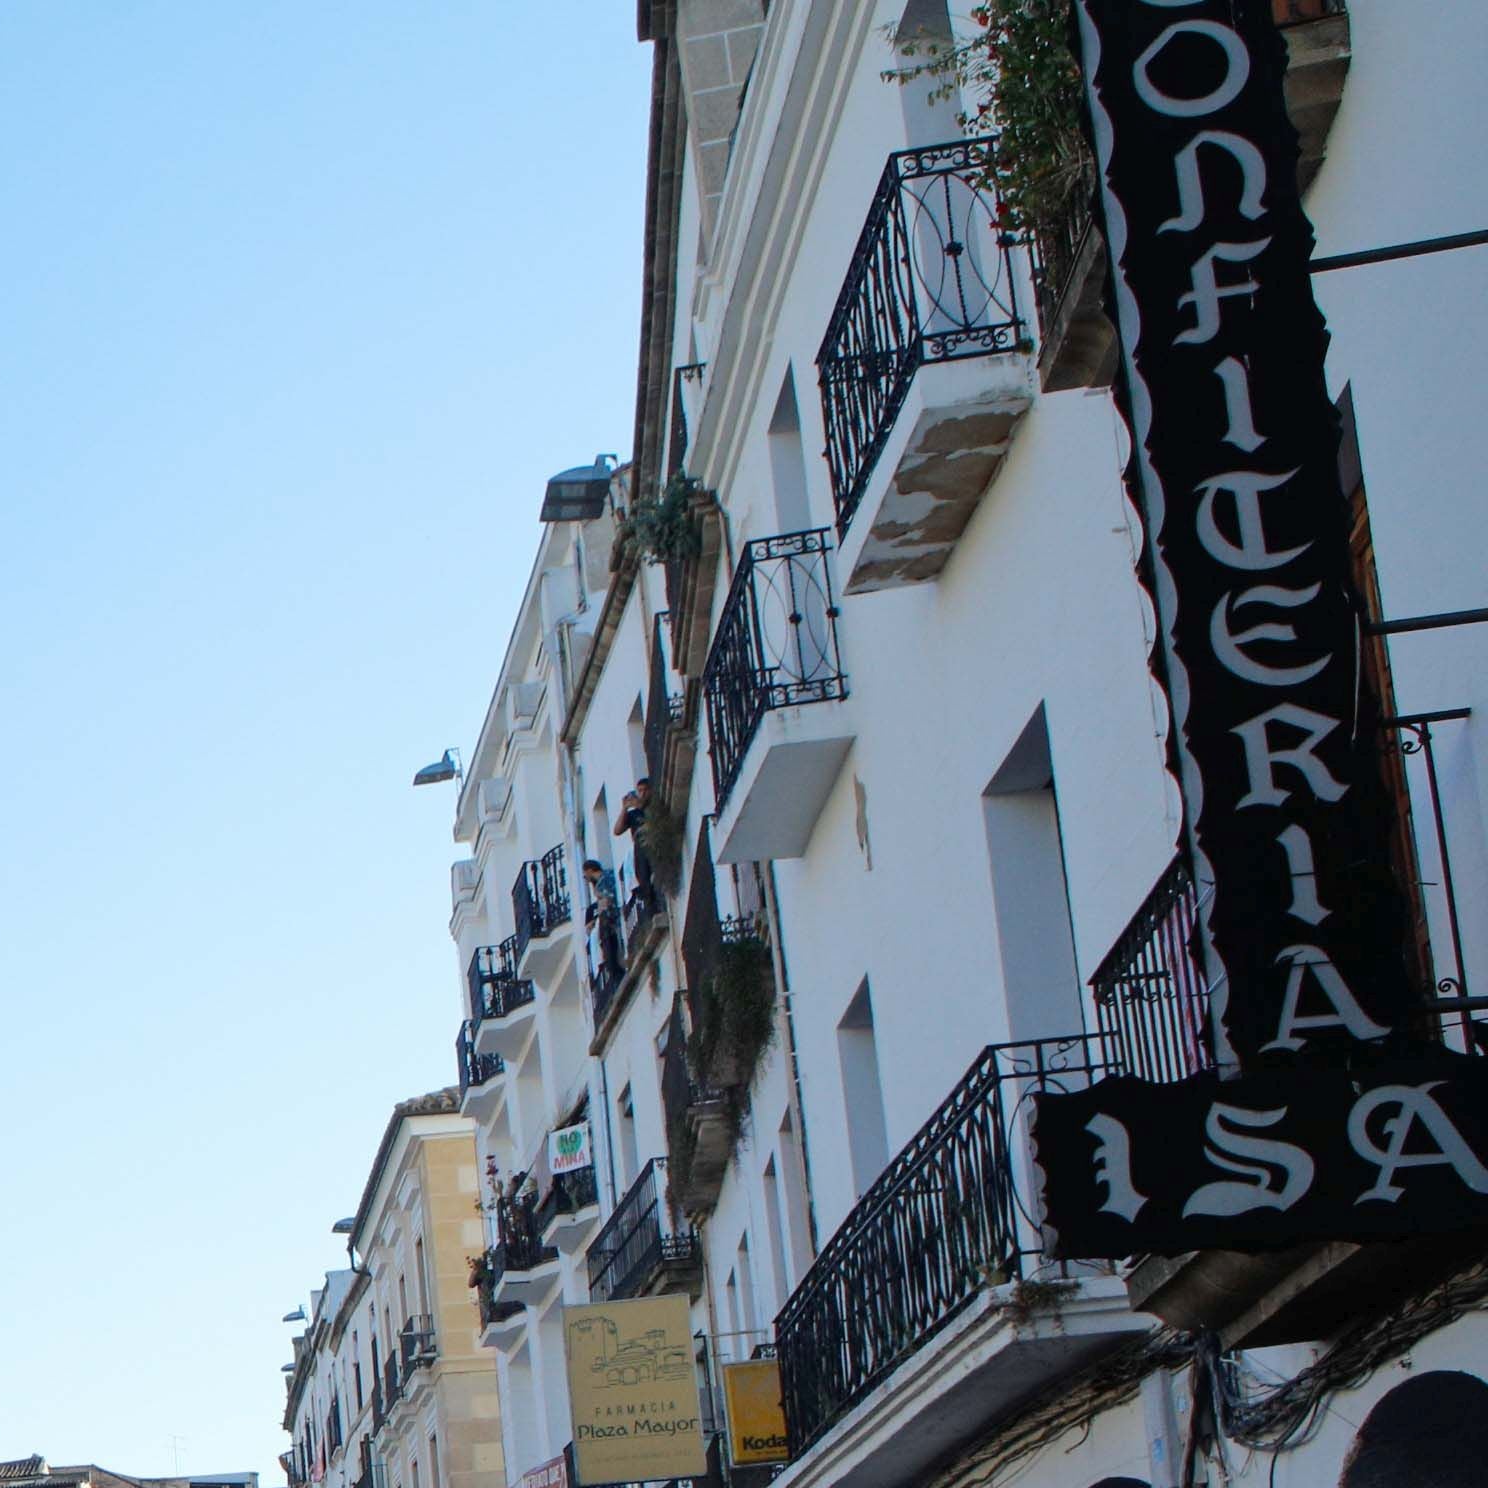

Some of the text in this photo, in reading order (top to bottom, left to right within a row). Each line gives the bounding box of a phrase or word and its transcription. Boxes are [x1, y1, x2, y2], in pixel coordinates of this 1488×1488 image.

[1133, 0, 1391, 1052] ONFITERIA
[595, 1401, 675, 1417] FARMACIA
[577, 1418, 699, 1439] Plaza Mayor
[743, 1434, 788, 1450] Koda
